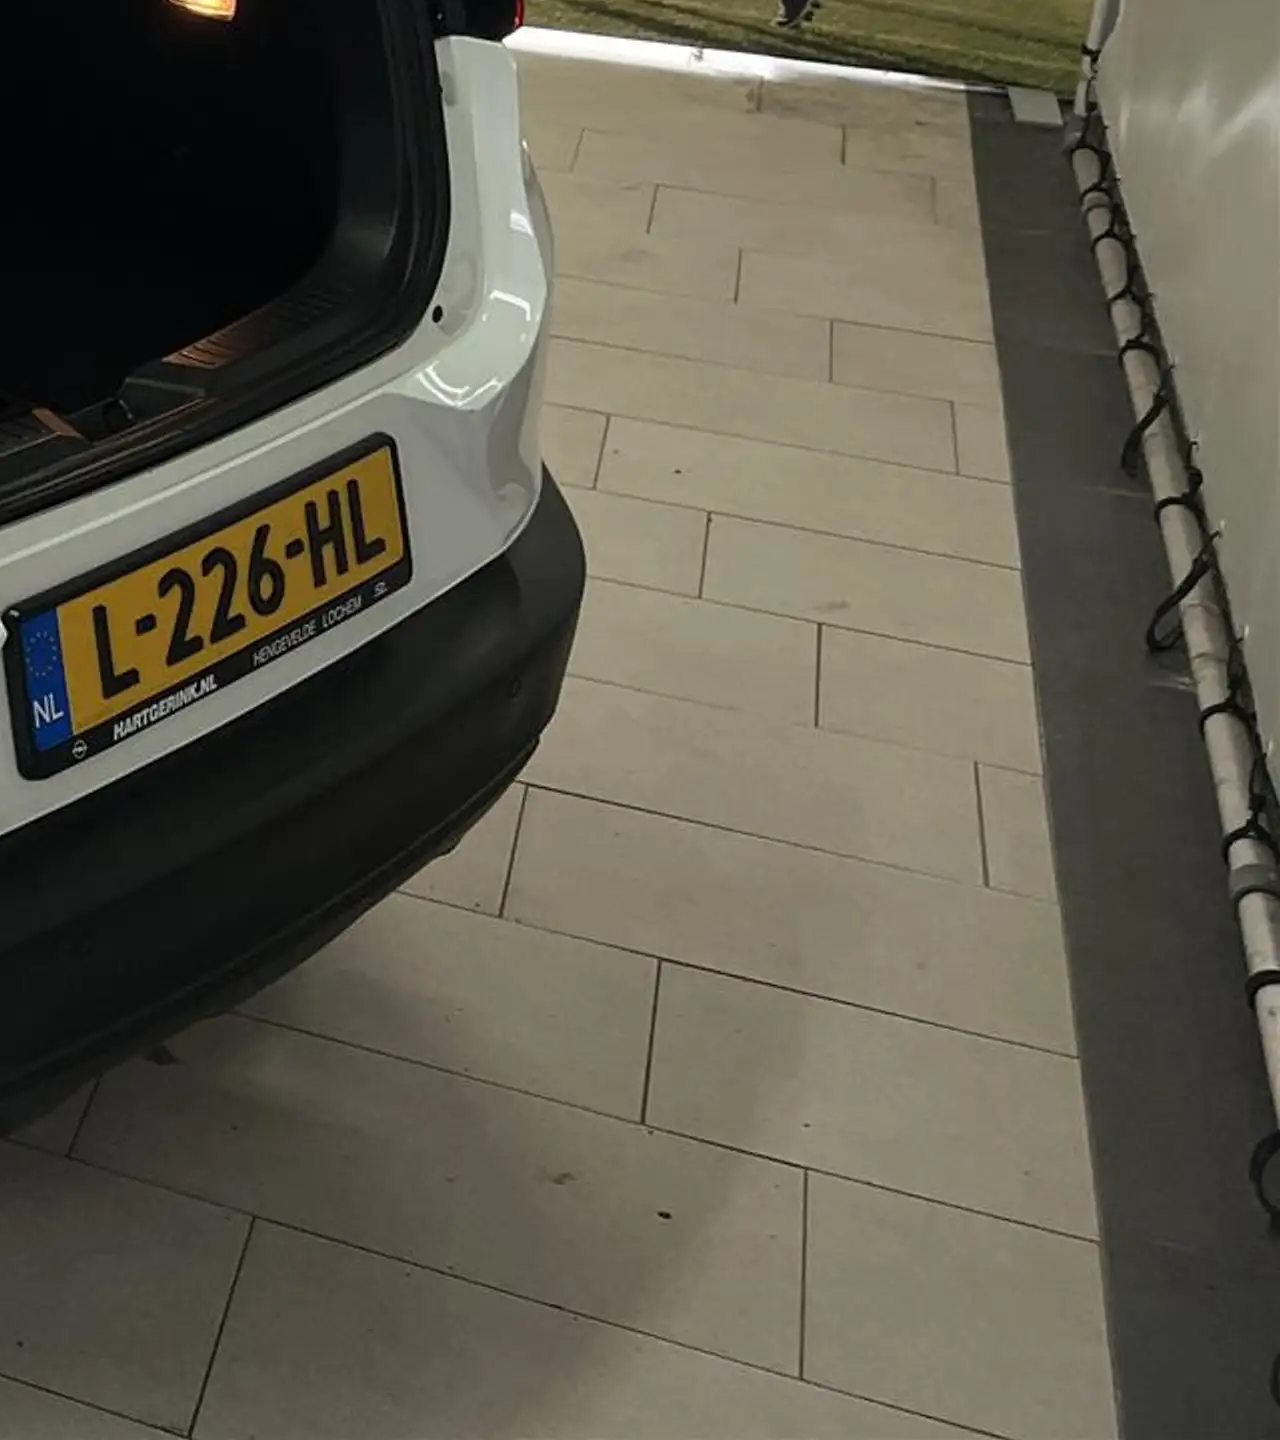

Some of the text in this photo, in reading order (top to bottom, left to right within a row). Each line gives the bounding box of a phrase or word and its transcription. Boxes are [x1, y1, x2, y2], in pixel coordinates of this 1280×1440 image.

[91, 478, 387, 700] L-226-HL
[252, 594, 362, 667] HENGEVELDE LOCHEM
[33, 692, 65, 729] NL
[113, 673, 218, 741] HARTGERINK.NL
